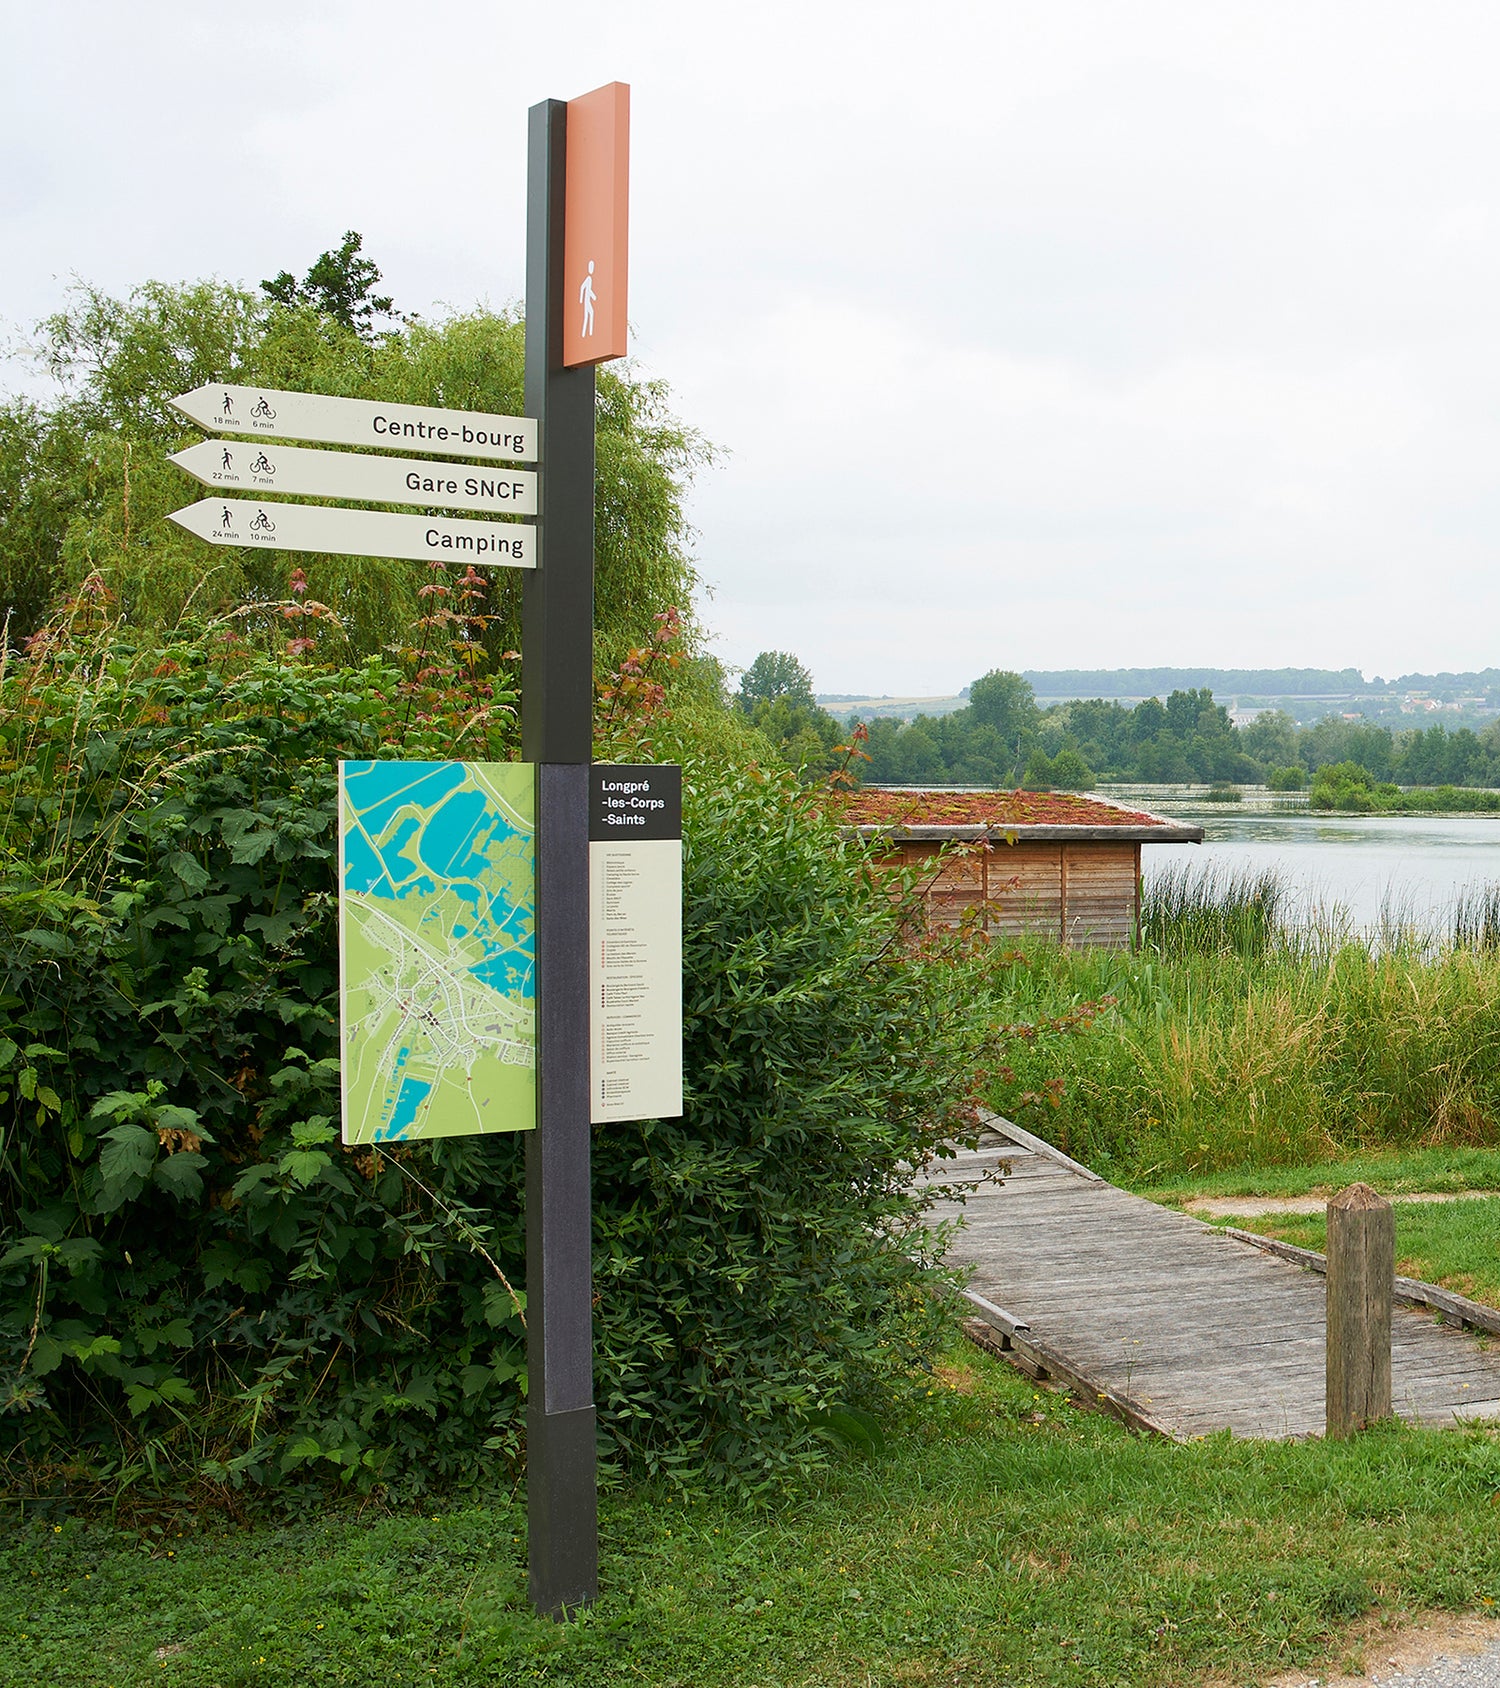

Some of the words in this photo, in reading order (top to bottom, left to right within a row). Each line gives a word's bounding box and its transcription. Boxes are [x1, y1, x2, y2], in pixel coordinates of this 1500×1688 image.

[372, 415, 525, 453] Centre-bourg
[212, 472, 223, 480] 22
[405, 472, 458, 494] Gare
[464, 477, 525, 500] SNCF
[250, 533, 260, 541] 10
[261, 534, 276, 542] min
[426, 529, 524, 559] Camping
[602, 780, 650, 794] Longpré
[602, 797, 665, 811] -les-Corps
[602, 813, 646, 825] -Saints
